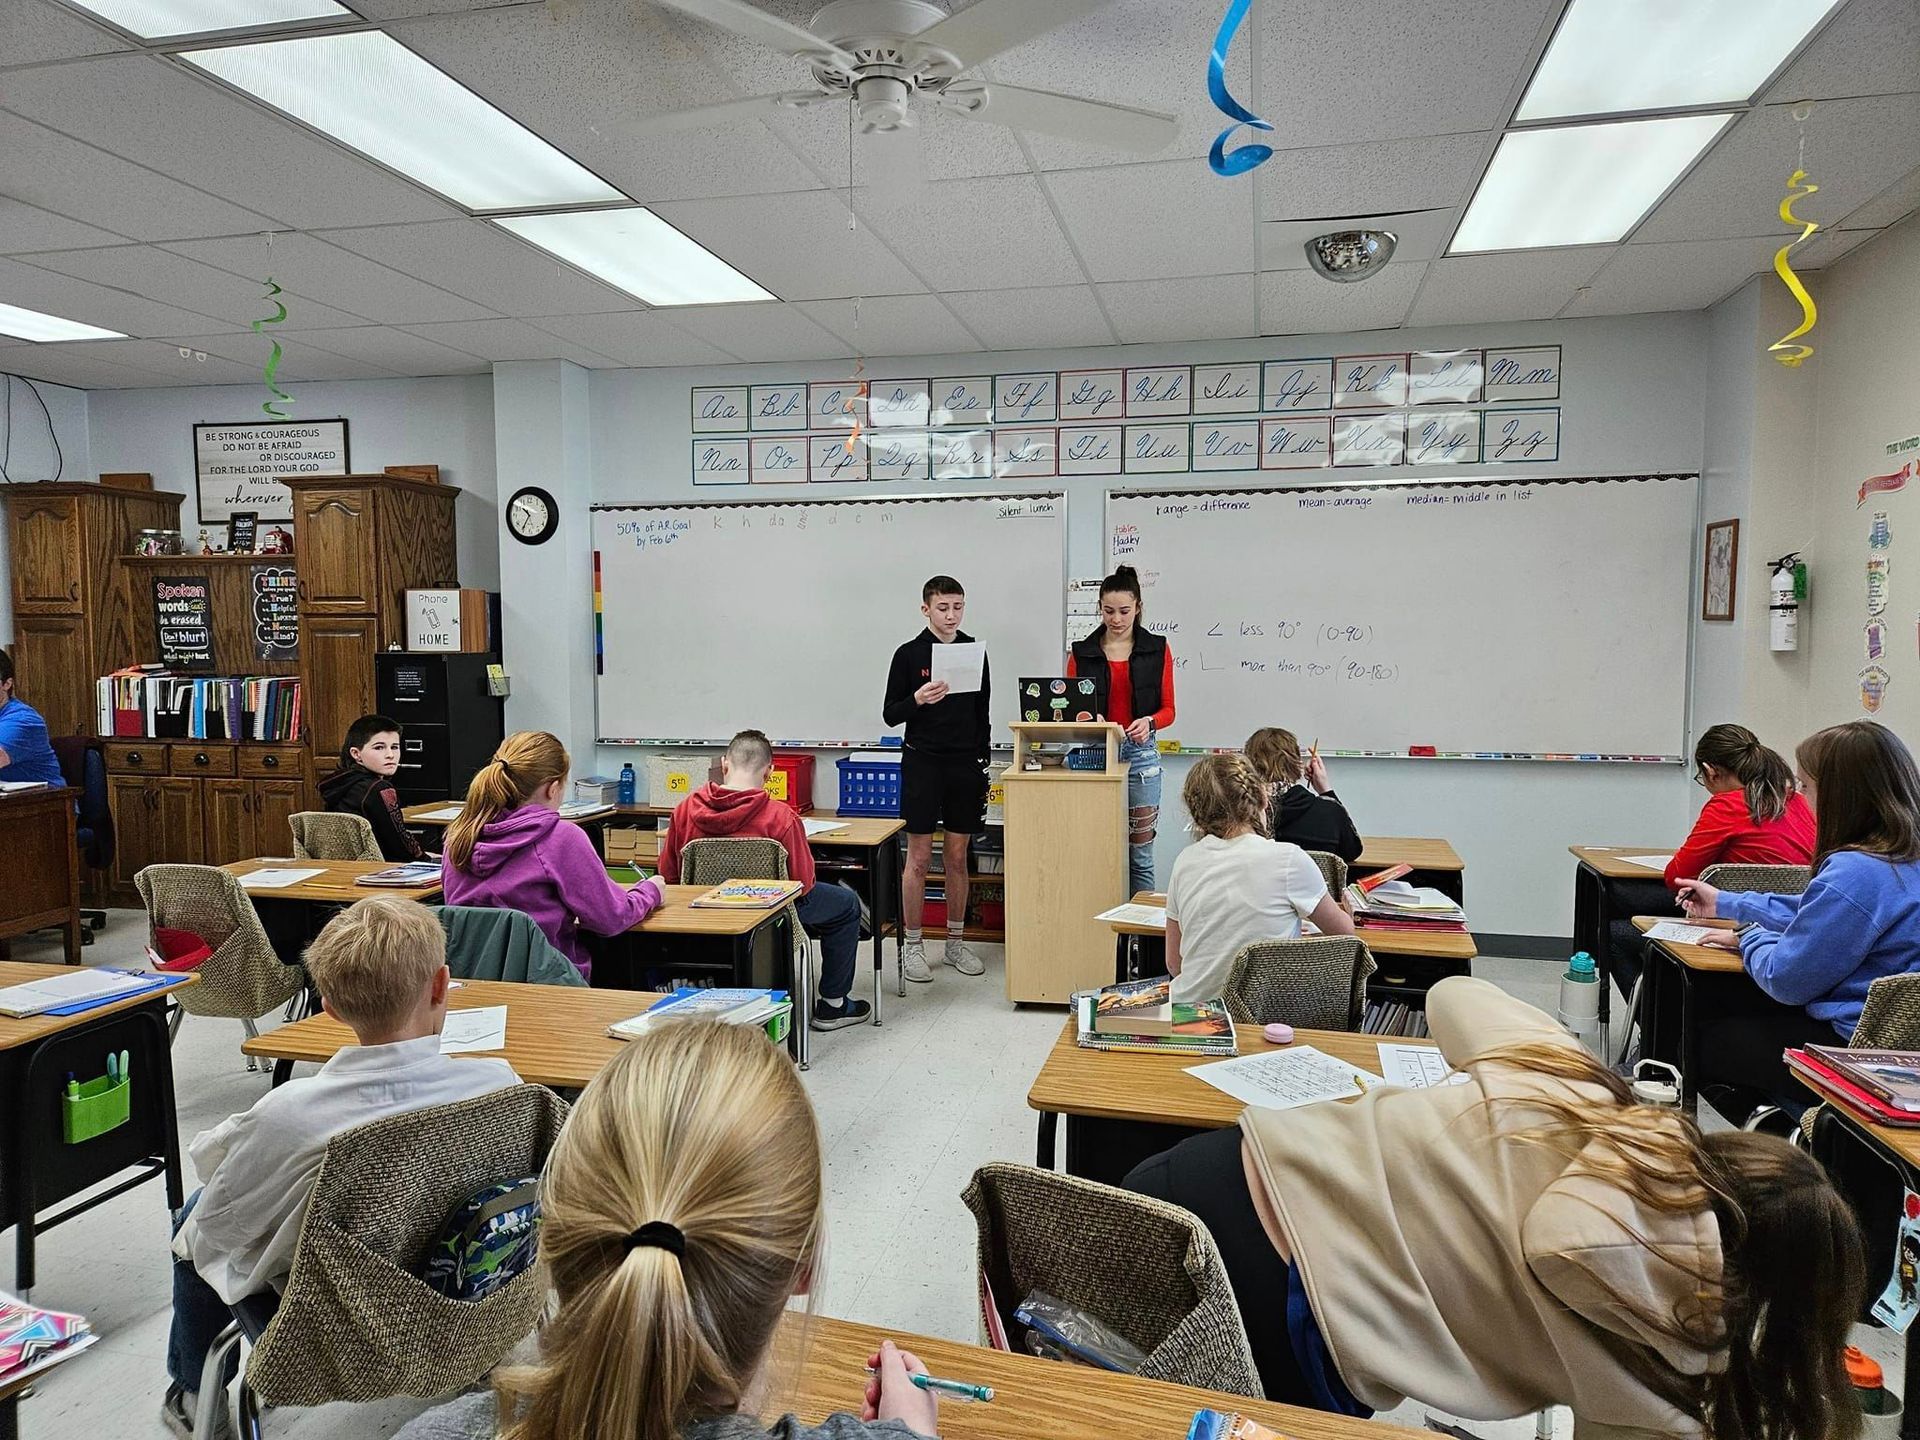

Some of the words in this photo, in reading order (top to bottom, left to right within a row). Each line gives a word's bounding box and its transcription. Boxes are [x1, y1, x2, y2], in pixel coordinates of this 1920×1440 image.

[205, 433, 216, 441] BE
[218, 432, 253, 440] STRONG
[261, 429, 320, 439] COURAGEOUS
[238, 443, 255, 451] NOT
[258, 442, 269, 450] BE
[271, 441, 301, 449] AFRAID
[260, 454, 272, 462] OR
[274, 451, 336, 461] DISCOURAGED
[230, 466, 246, 474] THE
[248, 465, 272, 473] LORD
[273, 464, 297, 472] YOUR
[299, 464, 319, 472] GOD
[248, 477, 270, 485] WILL
[272, 477, 282, 485] B
[224, 485, 284, 504] wherever
[1453, 492, 1490, 504] middle
[1496, 491, 1507, 501] in
[1514, 489, 1533, 500] list
[1030, 503, 1054, 513] lunch
[1156, 503, 1190, 519] range
[1200, 499, 1251, 511] difference
[616, 522, 641, 536] 50%
[645, 520, 655, 533] of
[672, 519, 691, 530] Goal
[636, 536, 646, 550] by
[649, 535, 663, 545] Feb
[664, 533, 679, 544] 6th
[261, 576, 297, 587] THINK
[157, 582, 205, 600] Spoken
[418, 594, 448, 604] Phone
[158, 600, 188, 613] words
[171, 614, 205, 625] erased.
[1149, 621, 1180, 633] acute
[1240, 621, 1264, 637] less
[180, 630, 206, 643] blurt
[419, 633, 449, 645] HOME
[1241, 660, 1266, 672] more
[1278, 659, 1301, 673] than
[671, 777, 685, 789] 5th
[990, 789, 1004, 801] 6th
